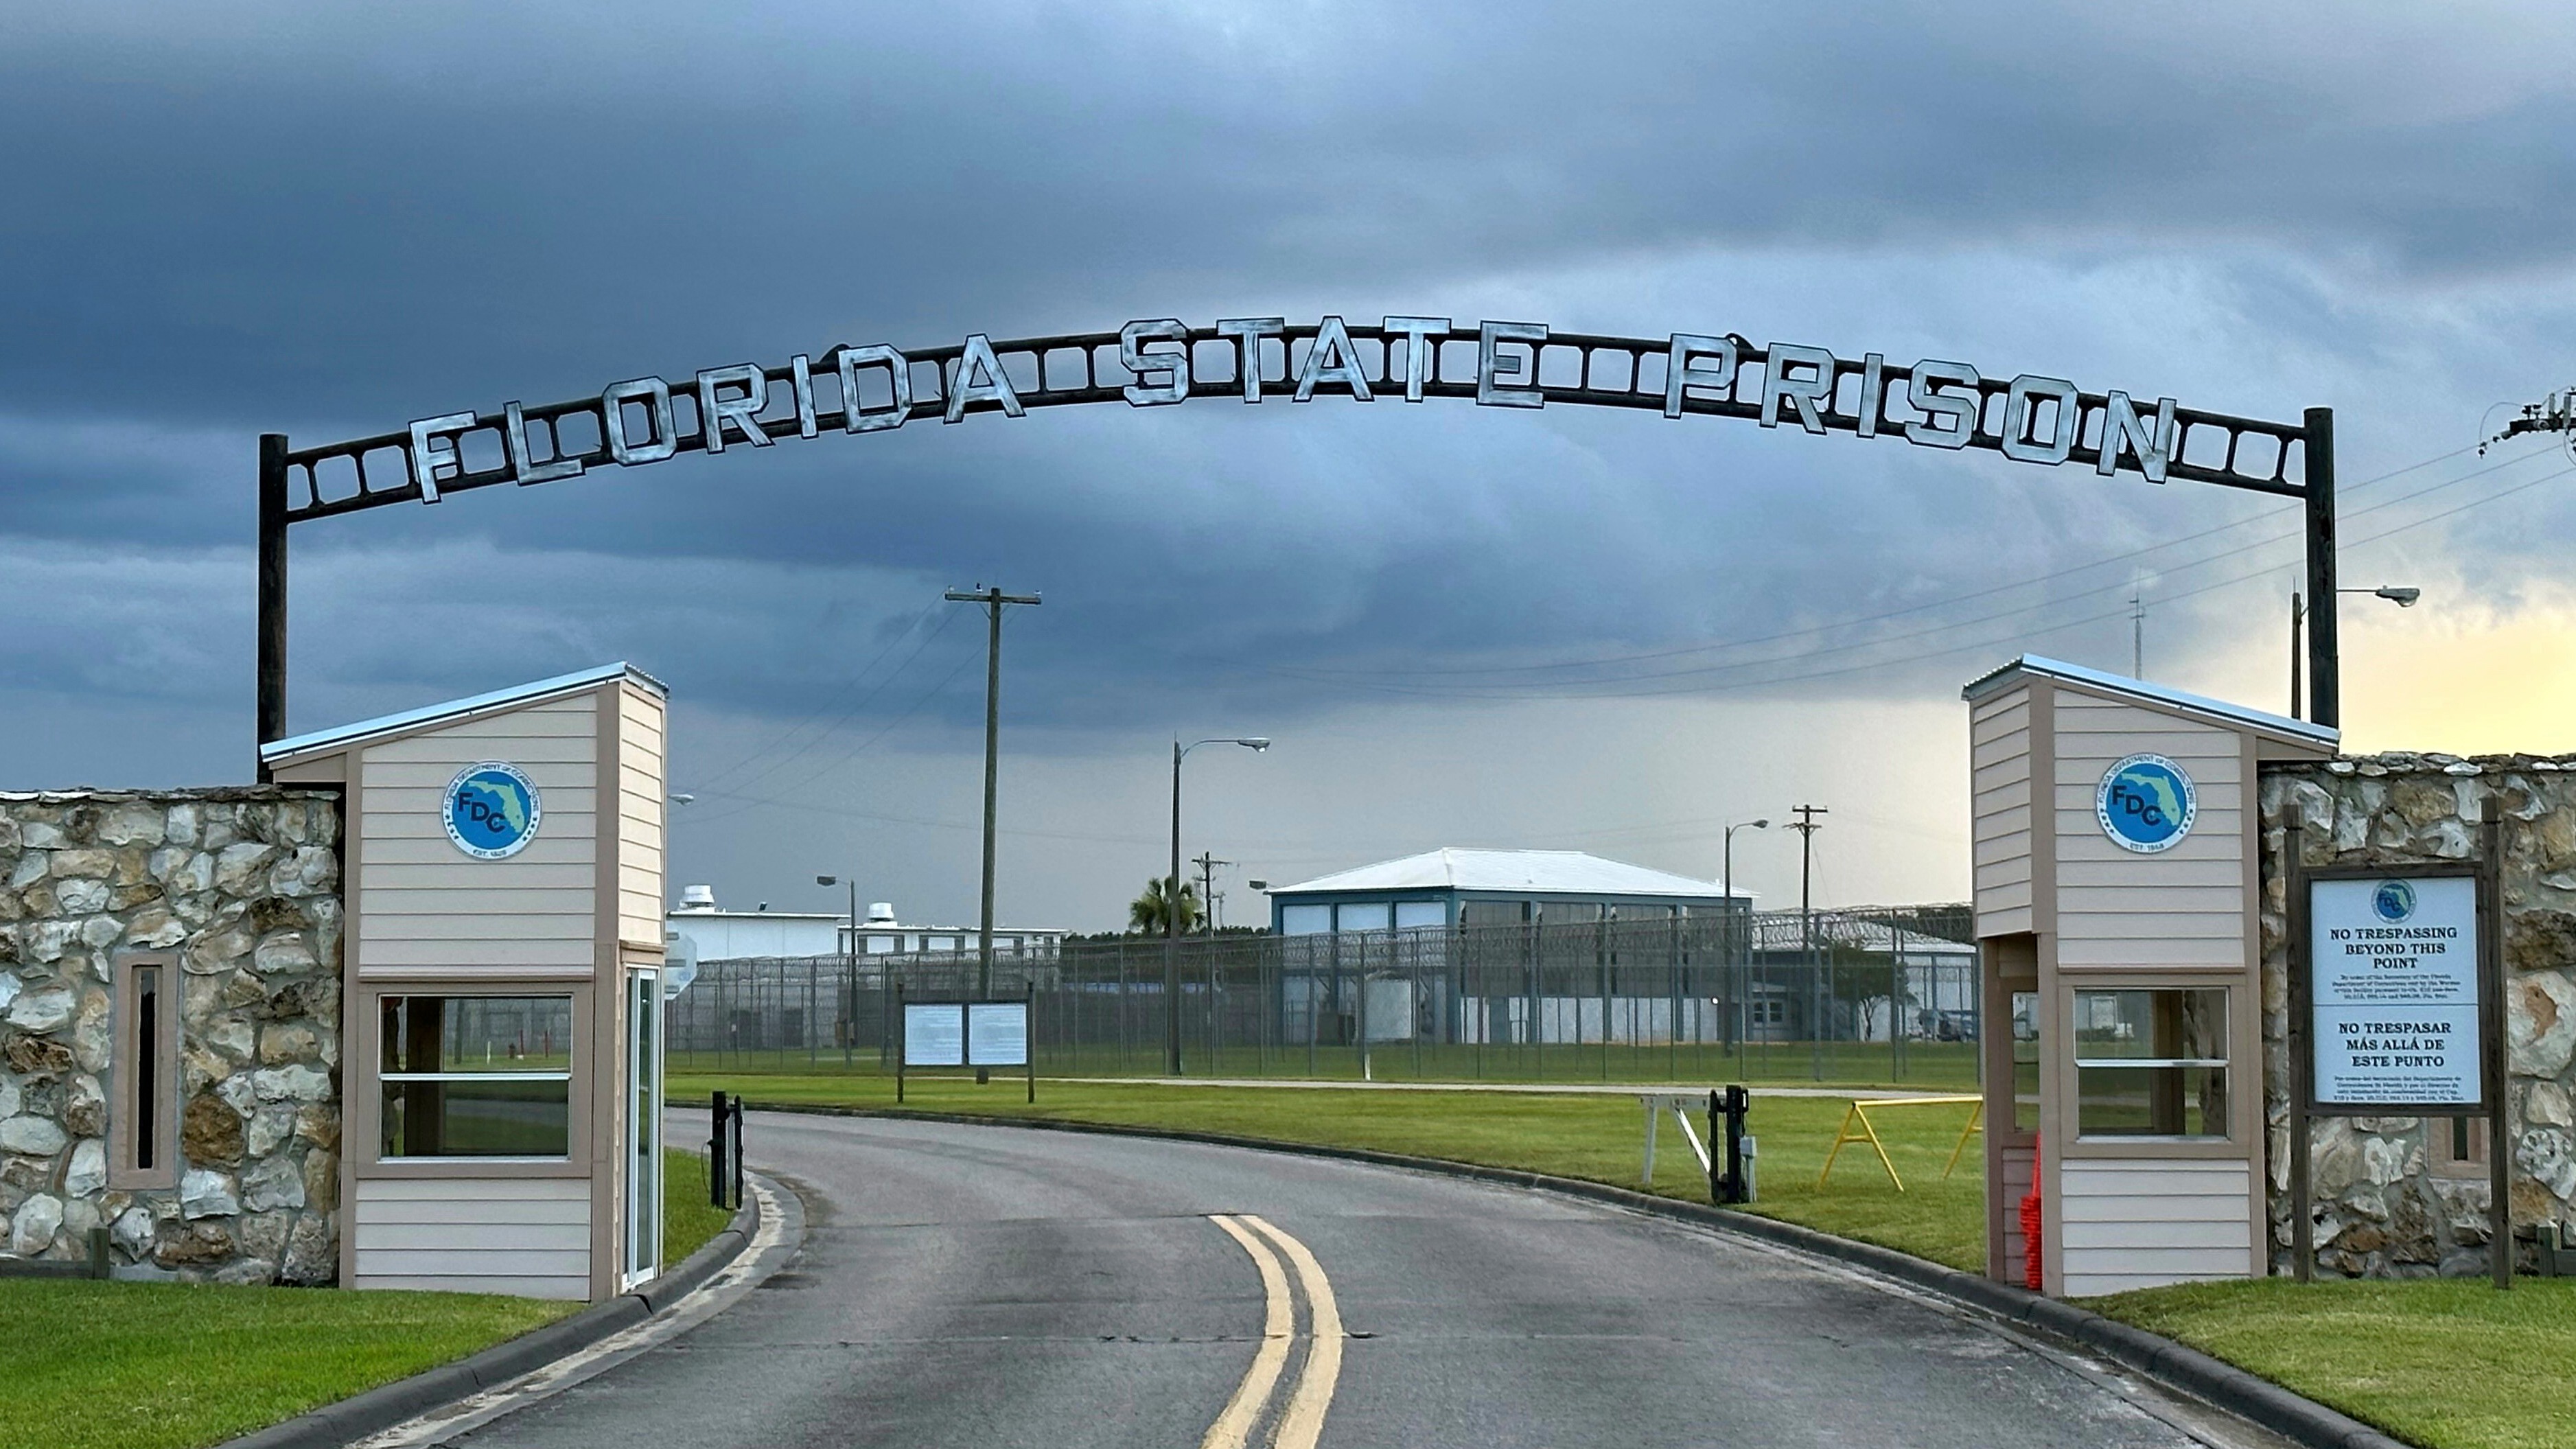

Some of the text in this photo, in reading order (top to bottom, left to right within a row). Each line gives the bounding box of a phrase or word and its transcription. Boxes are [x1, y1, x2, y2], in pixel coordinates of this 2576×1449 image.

[408, 316, 2177, 505] FLORIDA STATE PRISON
[2111, 785, 2161, 826] FDC
[458, 792, 507, 833] FDC
[2378, 893, 2402, 912] FDC
[2330, 927, 2457, 940] NO TRESPASSING
[2345, 943, 2446, 955] BEYOND THIS
[2374, 958, 2417, 969] POINT
[2339, 1023, 2451, 1034] NO TRESPASAR
[2346, 1036, 2445, 1050] MÁS ALLÁ DE
[2352, 1056, 2444, 1067] ESTE PUNTO
